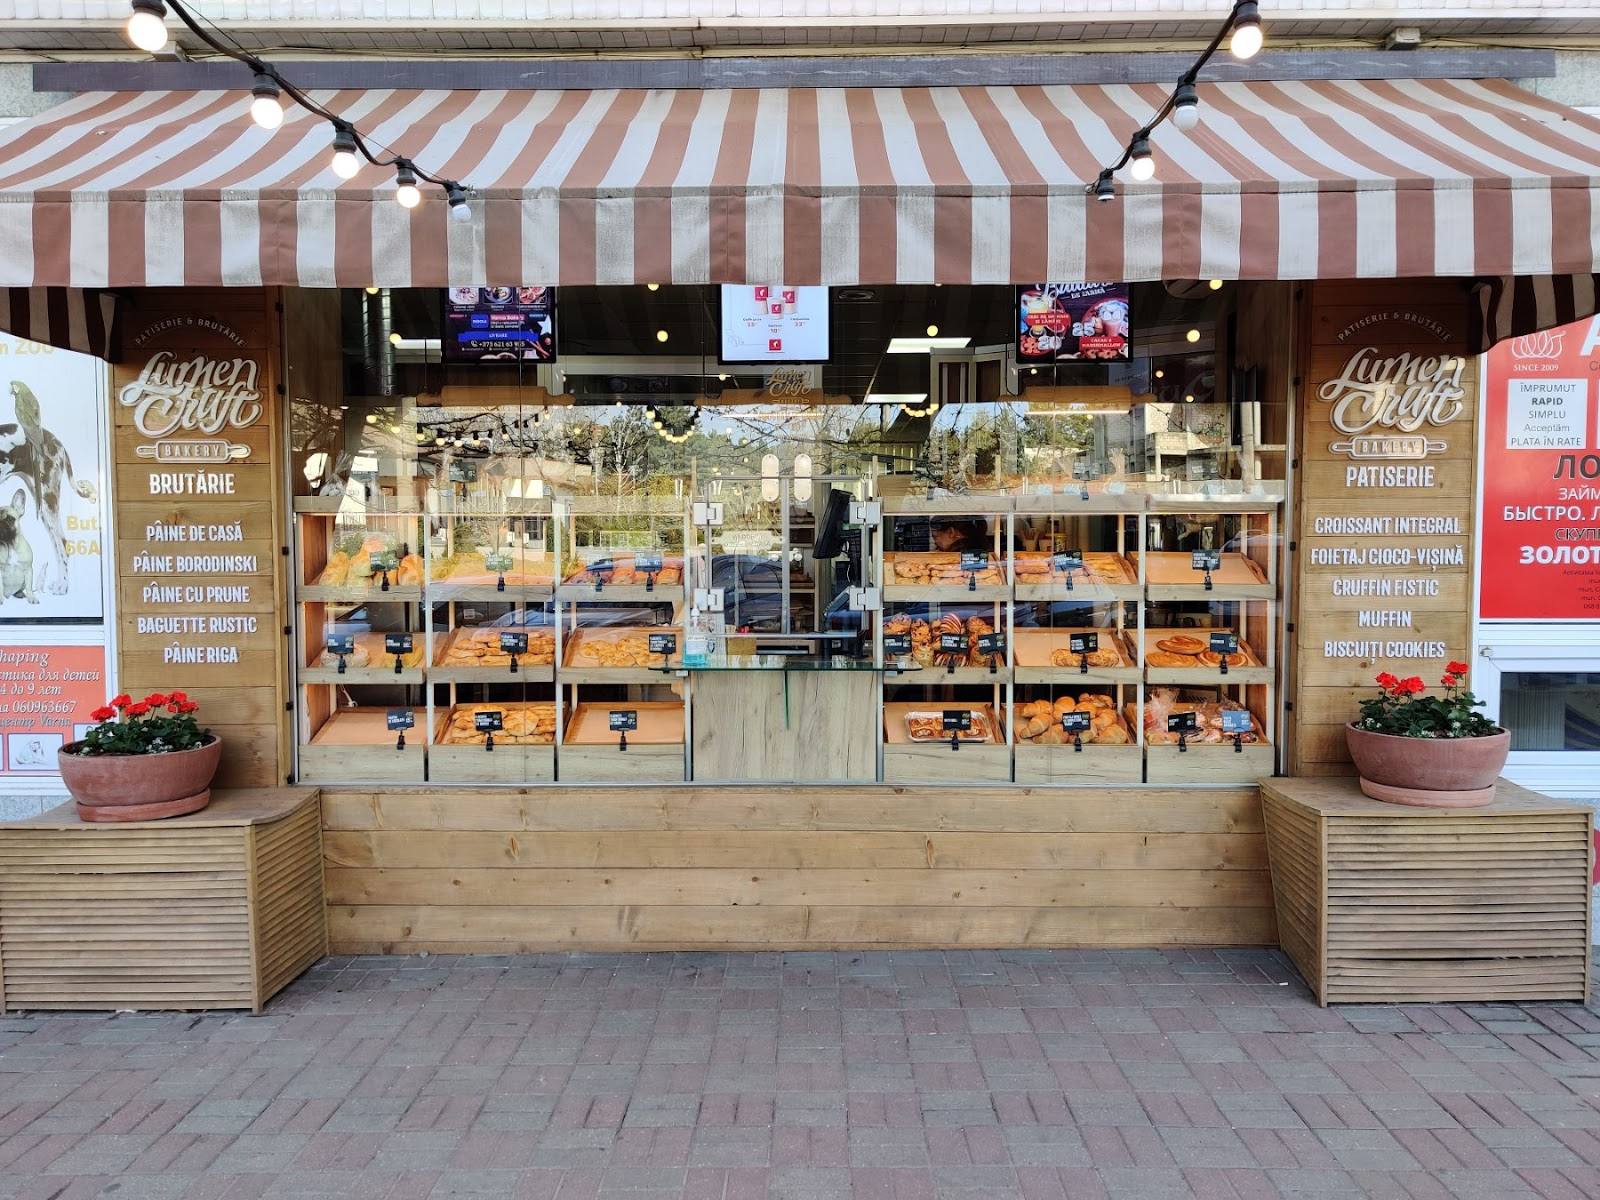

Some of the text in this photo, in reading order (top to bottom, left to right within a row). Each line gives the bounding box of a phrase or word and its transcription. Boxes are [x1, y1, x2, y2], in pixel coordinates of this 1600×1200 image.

[135, 318, 183, 345] PATISERIE
[1072, 321, 1095, 336] 25
[1338, 312, 1388, 341] PATISERIE
[120, 351, 259, 406] Lumen
[1317, 347, 1466, 400] Lumen
[1520, 382, 1576, 393] ÎMPRUMUT
[134, 381, 262, 437] Craft
[1331, 378, 1465, 434] Craft
[1531, 397, 1563, 406] RAPID
[1528, 410, 1566, 419] SIMPLU
[164, 444, 221, 457] BAKERY
[1362, 440, 1419, 453] BAKERY
[1511, 437, 1541, 446] PLATA
[1557, 437, 1581, 446] RATE
[149, 469, 236, 494] BRUTĂRIE
[1346, 465, 1435, 487] PATISERIE
[1503, 505, 1586, 521] БЫСТРО.
[146, 520, 243, 541] PÂINE DE CASĂ
[1314, 516, 1461, 534] CROISSANT INTEGRAL
[1555, 527, 1600, 541] СКУП
[133, 550, 257, 573] PÂINE BORODINSKI
[1311, 544, 1464, 573] FOIETAJ CIOCO-VIȘINĂ
[143, 581, 250, 603] PÂINE CU PRUNE
[1333, 579, 1439, 596] CRUFFIN FISTIC
[137, 616, 257, 634] BAGUETTE RUSTIC
[1358, 610, 1412, 627] MUFFIN
[164, 641, 239, 664] PÂINE RIGA
[1324, 641, 1446, 665] BISCUIȚI COOKIES
[39, 668, 60, 681] для
[11, 683, 24, 695] до
[28, 683, 35, 695] 9
[39, 685, 62, 695] лет
[12, 700, 76, 713] 060963667
